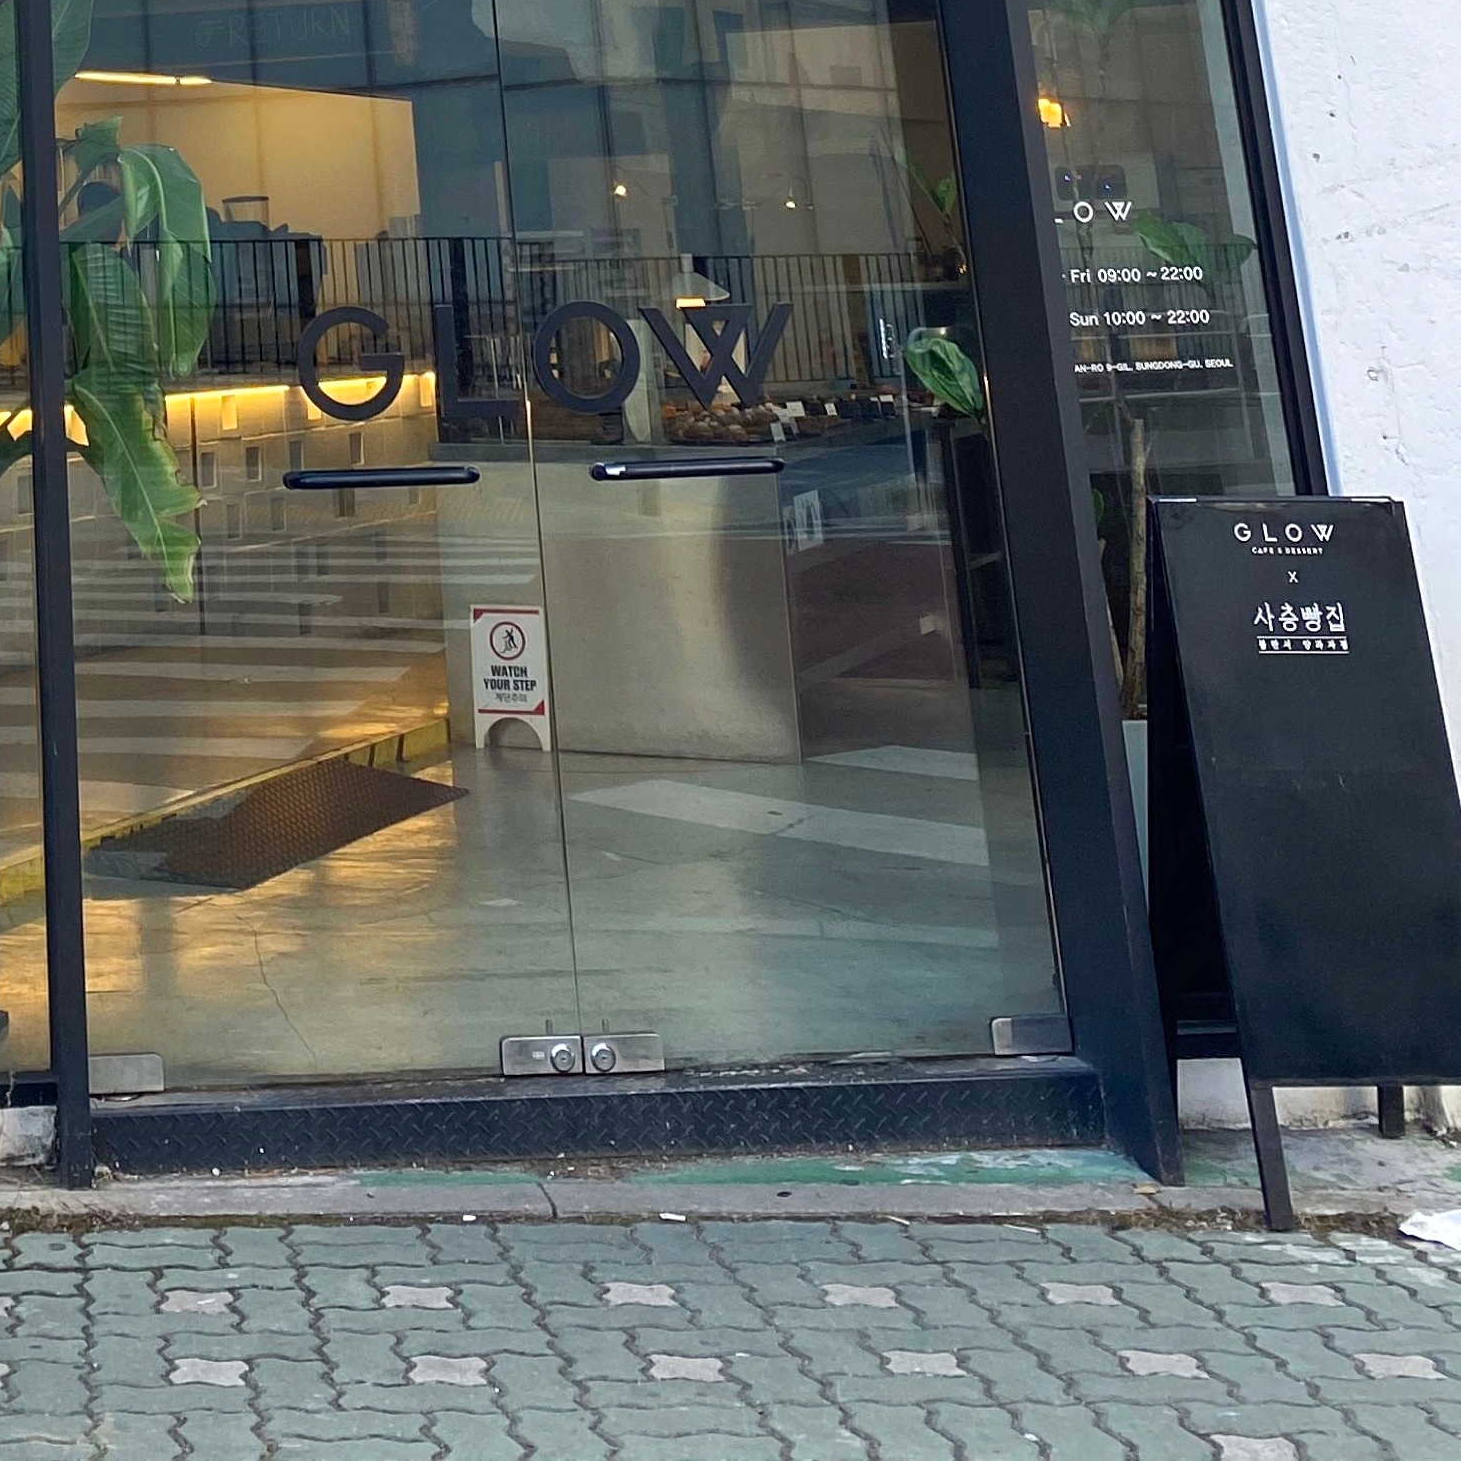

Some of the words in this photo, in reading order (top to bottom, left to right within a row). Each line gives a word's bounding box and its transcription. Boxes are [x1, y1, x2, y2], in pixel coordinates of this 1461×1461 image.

[1054, 201, 1133, 223] OW
[1070, 269, 1090, 283] Fri
[1097, 268, 1141, 283] 09:00
[1160, 266, 1203, 281] 22:00
[1069, 311, 1099, 327] Sun
[1103, 310, 1146, 326] 10:00
[1167, 309, 1210, 324] 22:00
[298, 301, 793, 420] GLOW
[1205, 358, 1233, 368] SEOUL
[1233, 522, 1334, 542] GLOW
[1253, 601, 1346, 633] 사층빵집
[490, 665, 529, 678] WATCH
[483, 678, 511, 691] YOUR
[513, 679, 537, 692] STEP
